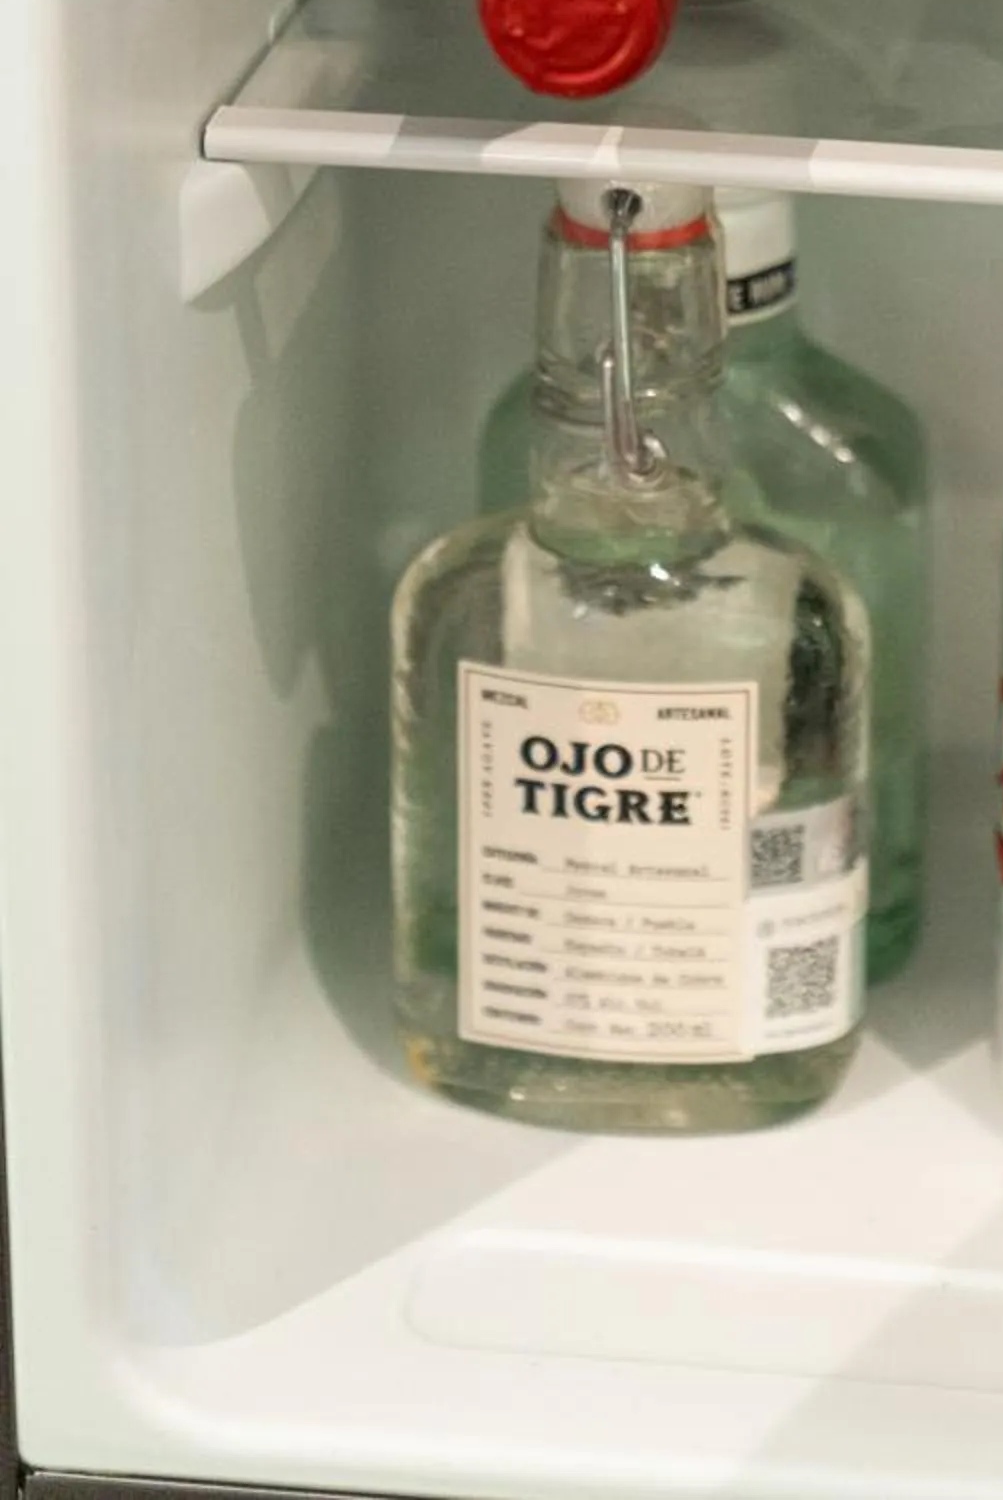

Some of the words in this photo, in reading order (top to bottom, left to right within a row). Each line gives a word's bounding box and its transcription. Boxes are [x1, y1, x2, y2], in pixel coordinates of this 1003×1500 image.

[519, 735, 634, 780] OJO
[640, 748, 686, 775] DE
[514, 777, 693, 826] TIGRE
